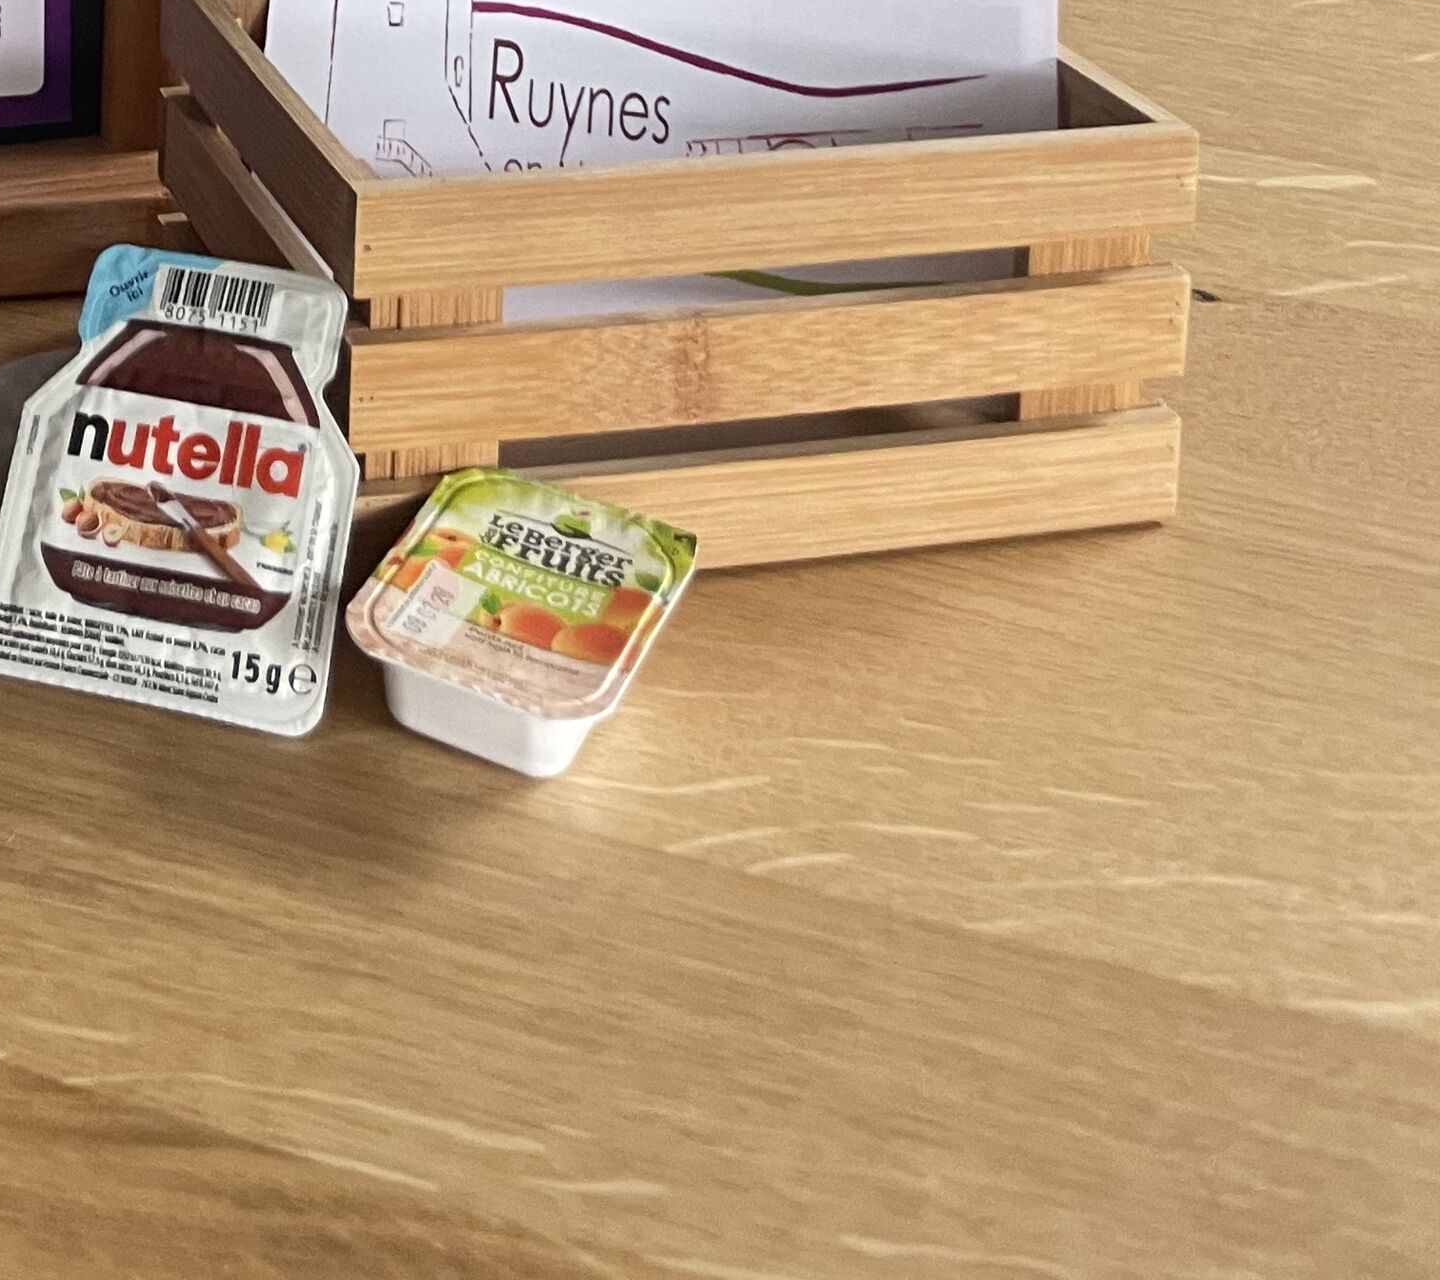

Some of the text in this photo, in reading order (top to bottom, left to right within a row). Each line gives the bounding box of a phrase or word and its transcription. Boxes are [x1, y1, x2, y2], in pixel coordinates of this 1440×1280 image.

[488, 37, 671, 168] Ruynes
[109, 269, 150, 298] Ouvrir
[66, 409, 306, 498] nutella
[462, 561, 602, 618] ABRICOTS
